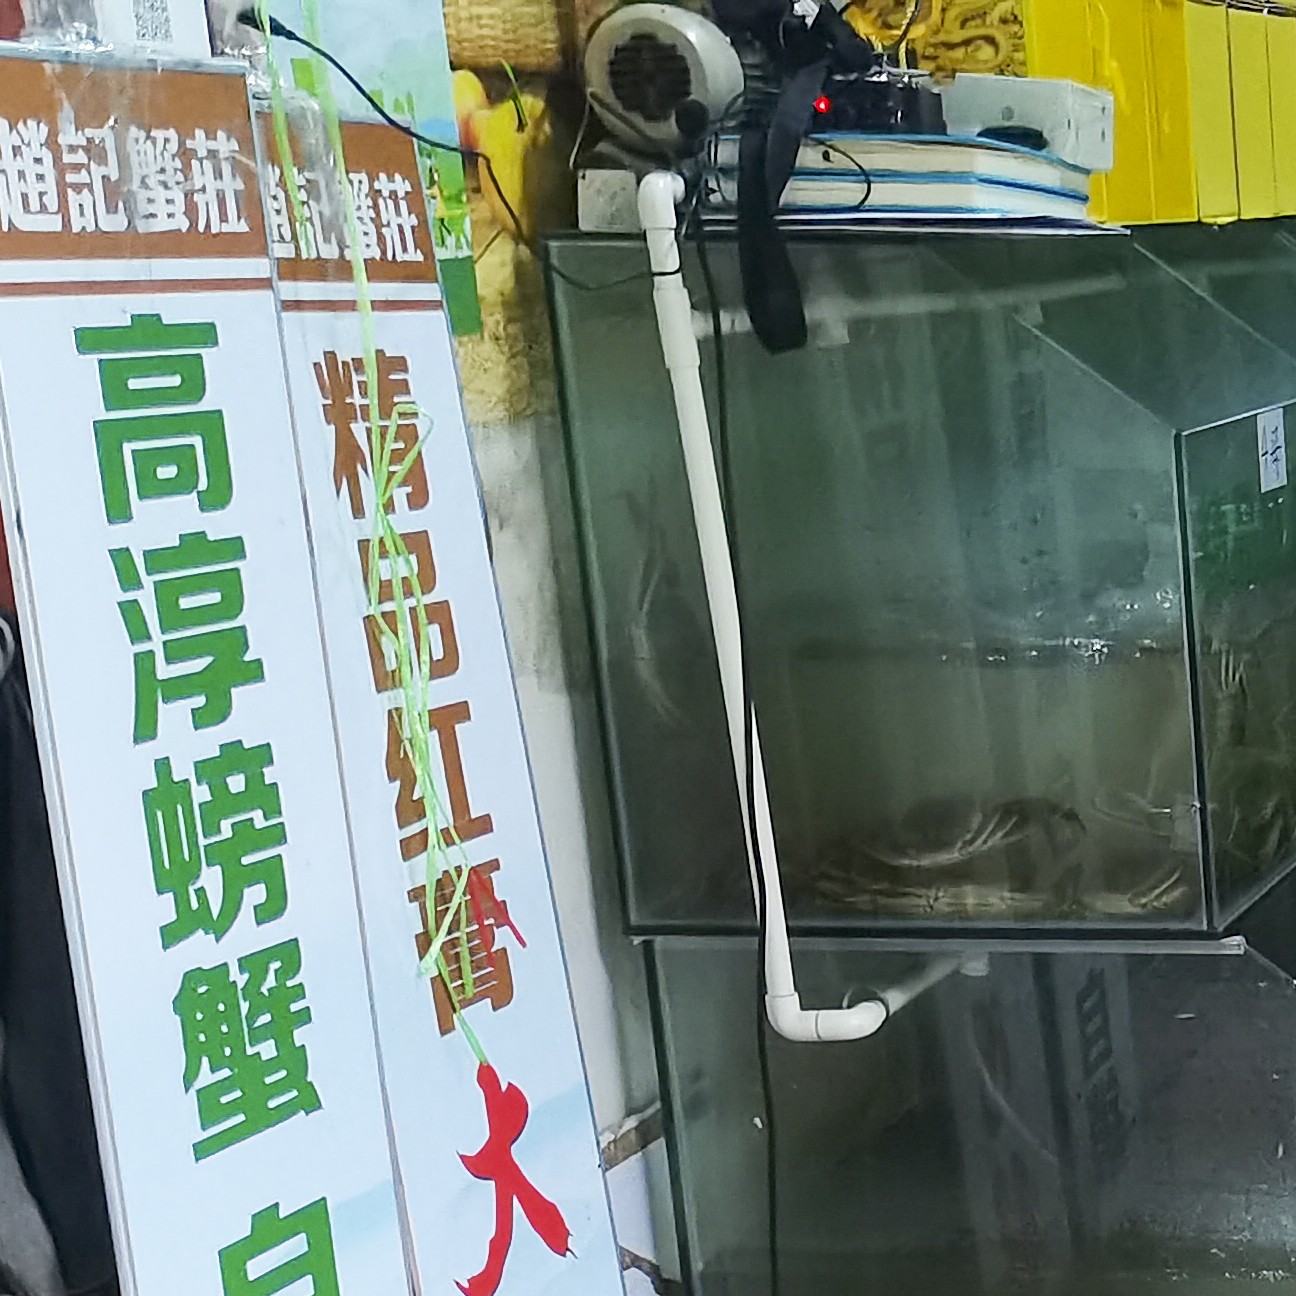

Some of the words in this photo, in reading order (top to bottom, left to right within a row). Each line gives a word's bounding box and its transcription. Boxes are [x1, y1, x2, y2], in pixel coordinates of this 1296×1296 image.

[74, 313, 325, 1163] 高淳螃蟹
[312, 348, 515, 1037] 精品红膏
